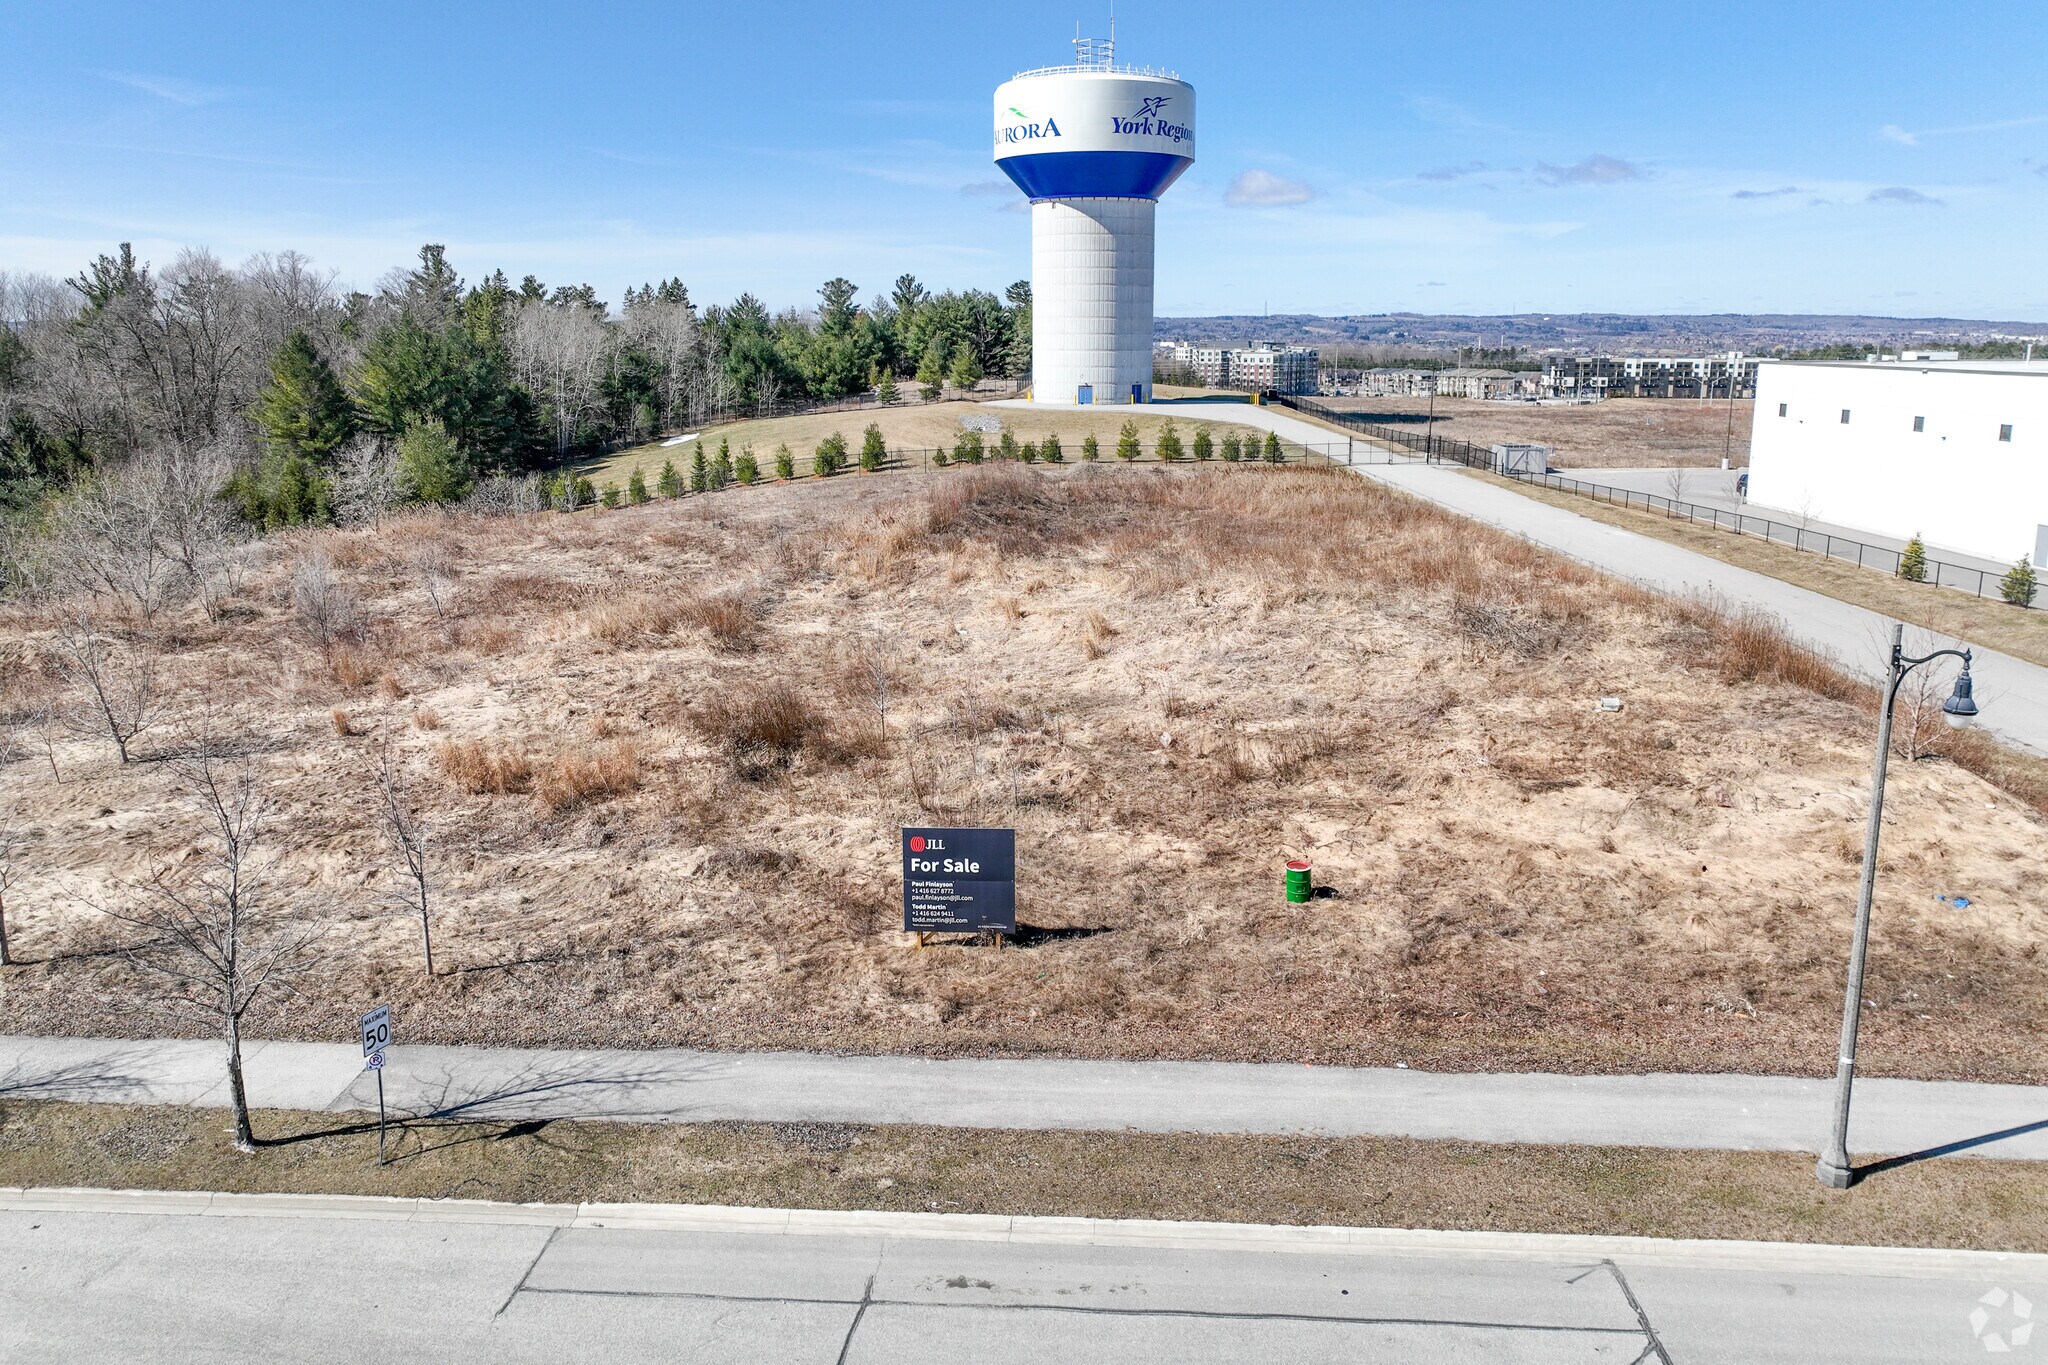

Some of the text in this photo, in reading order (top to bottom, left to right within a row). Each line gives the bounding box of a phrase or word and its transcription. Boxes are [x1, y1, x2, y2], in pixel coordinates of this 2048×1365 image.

[1111, 116, 1193, 143] York Region
[925, 839, 946, 850] JLL
[911, 858, 980, 873] For Sale
[911, 894, 974, 902] paul.finlayson@jll.com
[364, 1010, 387, 1025] MAXIMUM
[366, 1023, 388, 1050] 50
